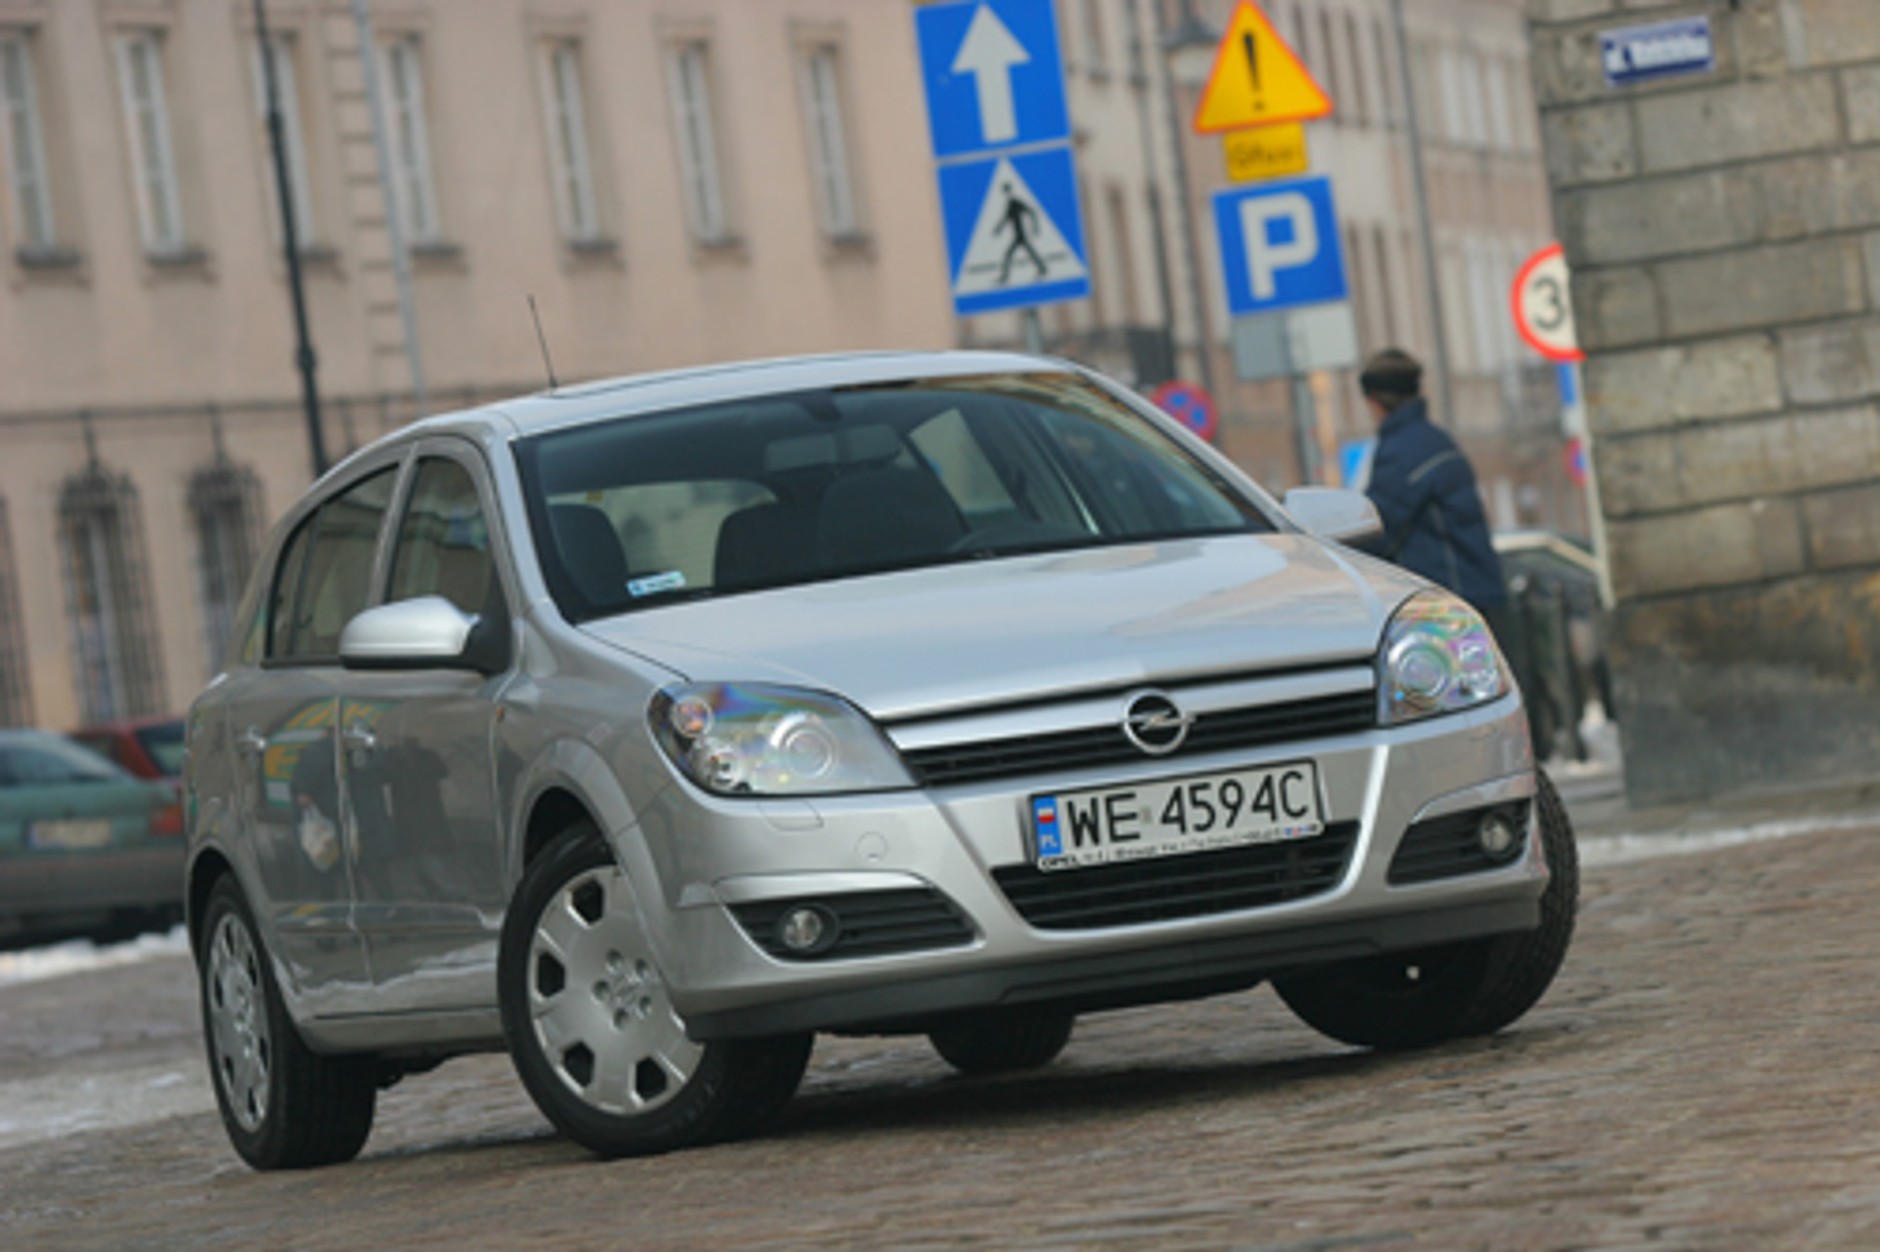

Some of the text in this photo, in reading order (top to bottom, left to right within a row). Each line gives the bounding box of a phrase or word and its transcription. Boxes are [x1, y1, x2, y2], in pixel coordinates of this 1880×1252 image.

[1240, 193, 1318, 299] P
[1532, 274, 1565, 331] 3
[1067, 793, 1140, 847] WE
[1160, 771, 1308, 834] 4594C
